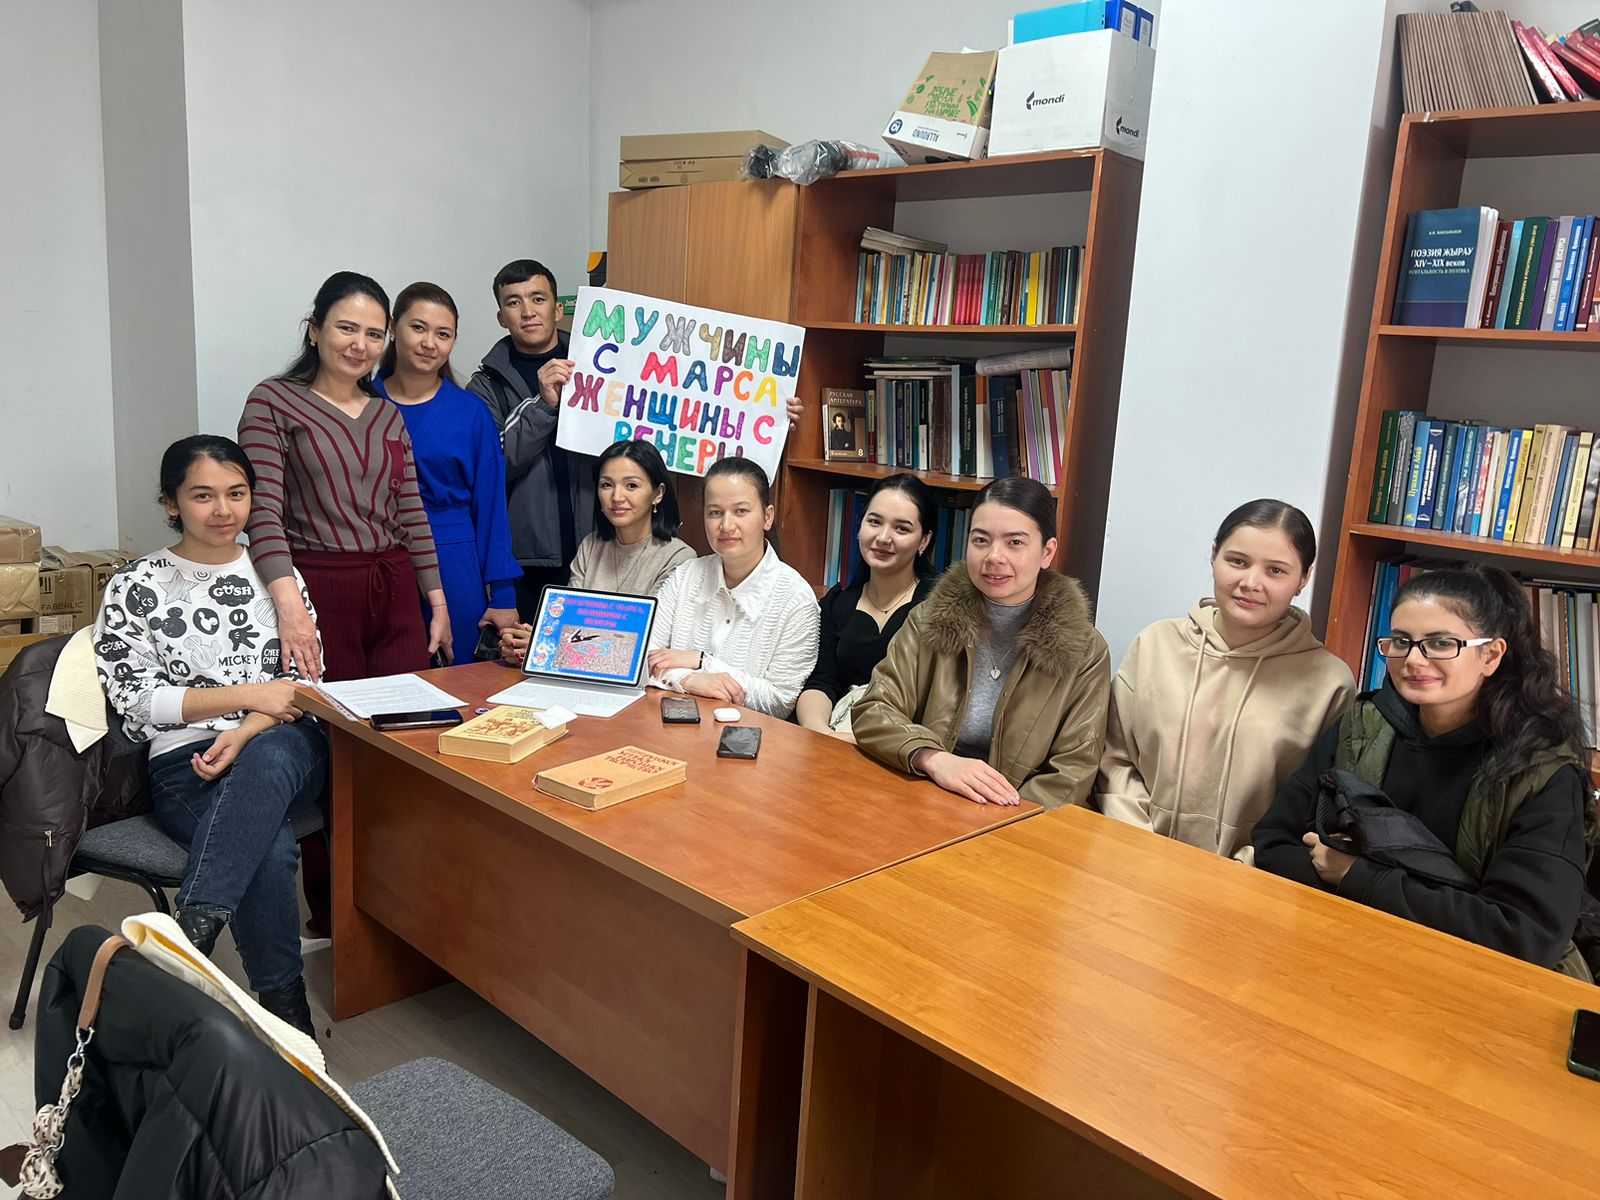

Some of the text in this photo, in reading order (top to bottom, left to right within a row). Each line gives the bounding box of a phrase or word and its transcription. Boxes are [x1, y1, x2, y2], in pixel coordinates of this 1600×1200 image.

[1032, 93, 1066, 107] mondi
[1120, 125, 1140, 138] mondi
[1410, 247, 1474, 258] ПОЭЗИЯ ЖЫРАУ
[582, 299, 801, 378] МУЖЧИНЫ
[593, 343, 778, 408] С МАРСА
[829, 391, 854, 399] РУССКАЯ
[567, 372, 775, 445] ЖЕНЩИНЫ С
[858, 448, 864, 457] 8
[1408, 470, 1419, 497] Пушкин
[213, 585, 252, 597] GOSH
[41, 601, 84, 611] FABERLIC
[218, 654, 260, 667] MICKEY
